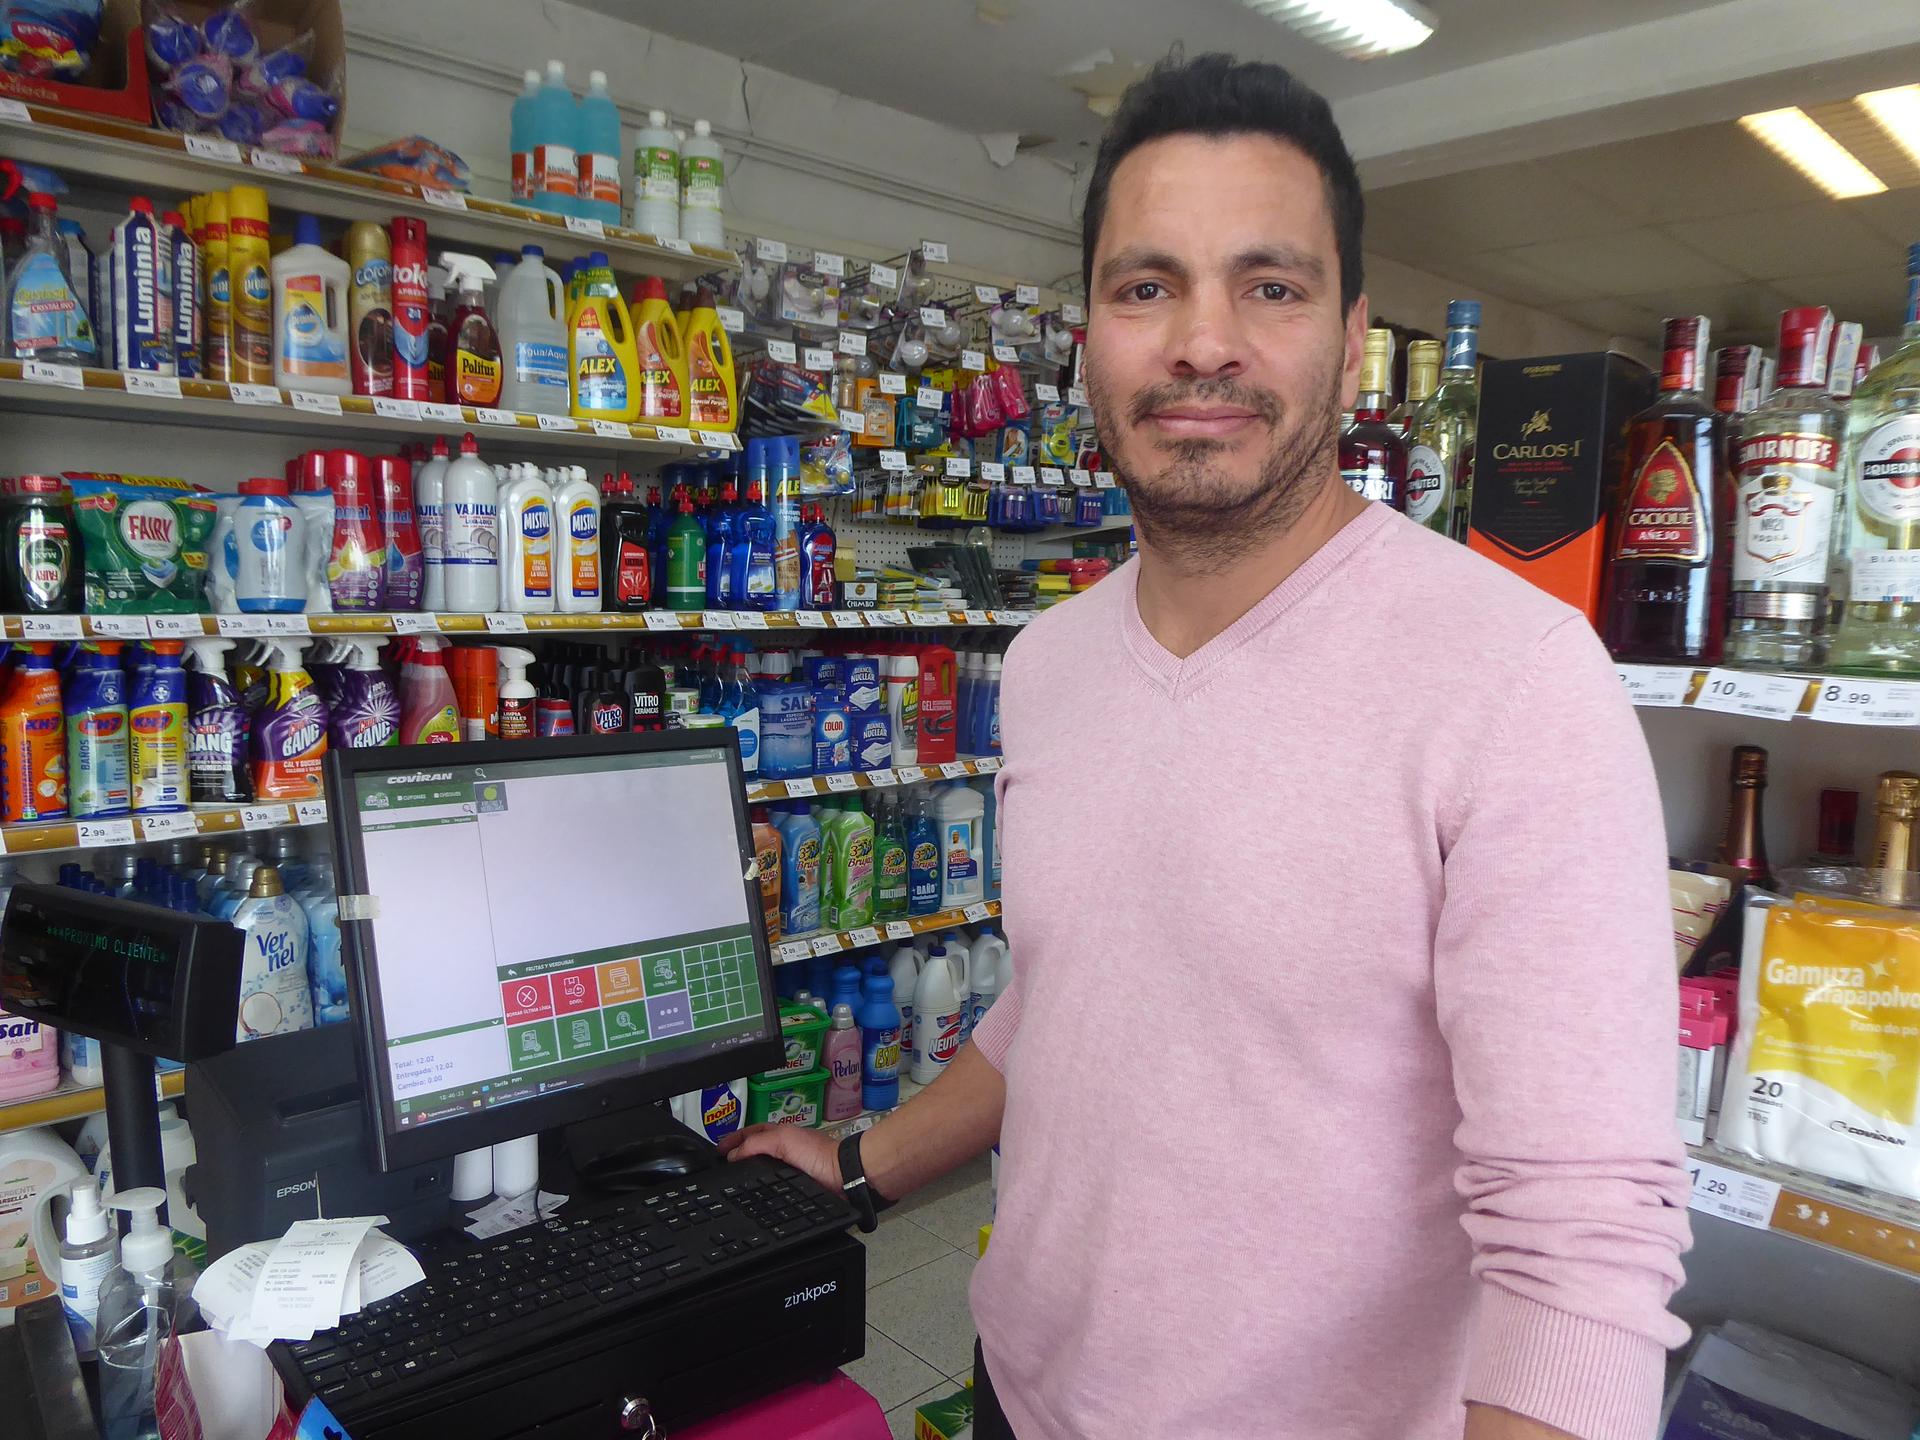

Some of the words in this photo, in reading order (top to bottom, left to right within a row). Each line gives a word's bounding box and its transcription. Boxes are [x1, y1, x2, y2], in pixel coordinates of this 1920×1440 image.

[463, 358, 495, 377] Politus
[579, 357, 616, 374] ALEX
[640, 370, 670, 384] ALEX
[691, 379, 721, 392] ALEX
[334, 504, 371, 521] omat
[1628, 512, 1695, 526] CACIQUE
[524, 511, 550, 531] MISTOL
[572, 513, 597, 532] MISTOL
[129, 515, 173, 543] FAIRY
[1638, 528, 1681, 541] AÑEJO
[35, 570, 58, 582] FAIRY
[847, 600, 875, 609] CHIMBO
[24, 620, 51, 631] 2.99
[94, 620, 120, 631] 4.79
[851, 673, 876, 683] NUCLEAR
[634, 694, 659, 708] VITRO
[1824, 685, 1872, 705] 8.99
[781, 695, 809, 712] SAL
[921, 700, 933, 711] GEL
[594, 708, 621, 724] VITRO
[602, 715, 622, 730] CLEN
[824, 720, 844, 732] COLON
[282, 723, 321, 757] BANG
[353, 720, 391, 749] BANG
[863, 728, 888, 739] NUCLEAR
[80, 738, 90, 772] BAÑOS
[147, 818, 171, 829] 2.49
[245, 811, 268, 822] 3.99
[81, 826, 106, 838] 2.99
[848, 857, 873, 868] Brujas
[916, 882, 936, 895] BAÑO
[256, 930, 288, 957] Ver
[268, 942, 295, 973] nel
[525, 963, 545, 972] FRUTAS
[1765, 957, 1865, 988] Gamuza
[1883, 1023, 1900, 1034] do
[783, 1058, 805, 1069] RIEL
[832, 1059, 861, 1080] Perlan
[1752, 1076, 1784, 1098] 20
[706, 1098, 737, 1123] norit
[778, 1114, 808, 1124] ARIEL
[276, 1178, 317, 1200] EPSON
[1690, 1168, 1728, 1196] 1.29
[783, 1279, 838, 1310] zinkpos
